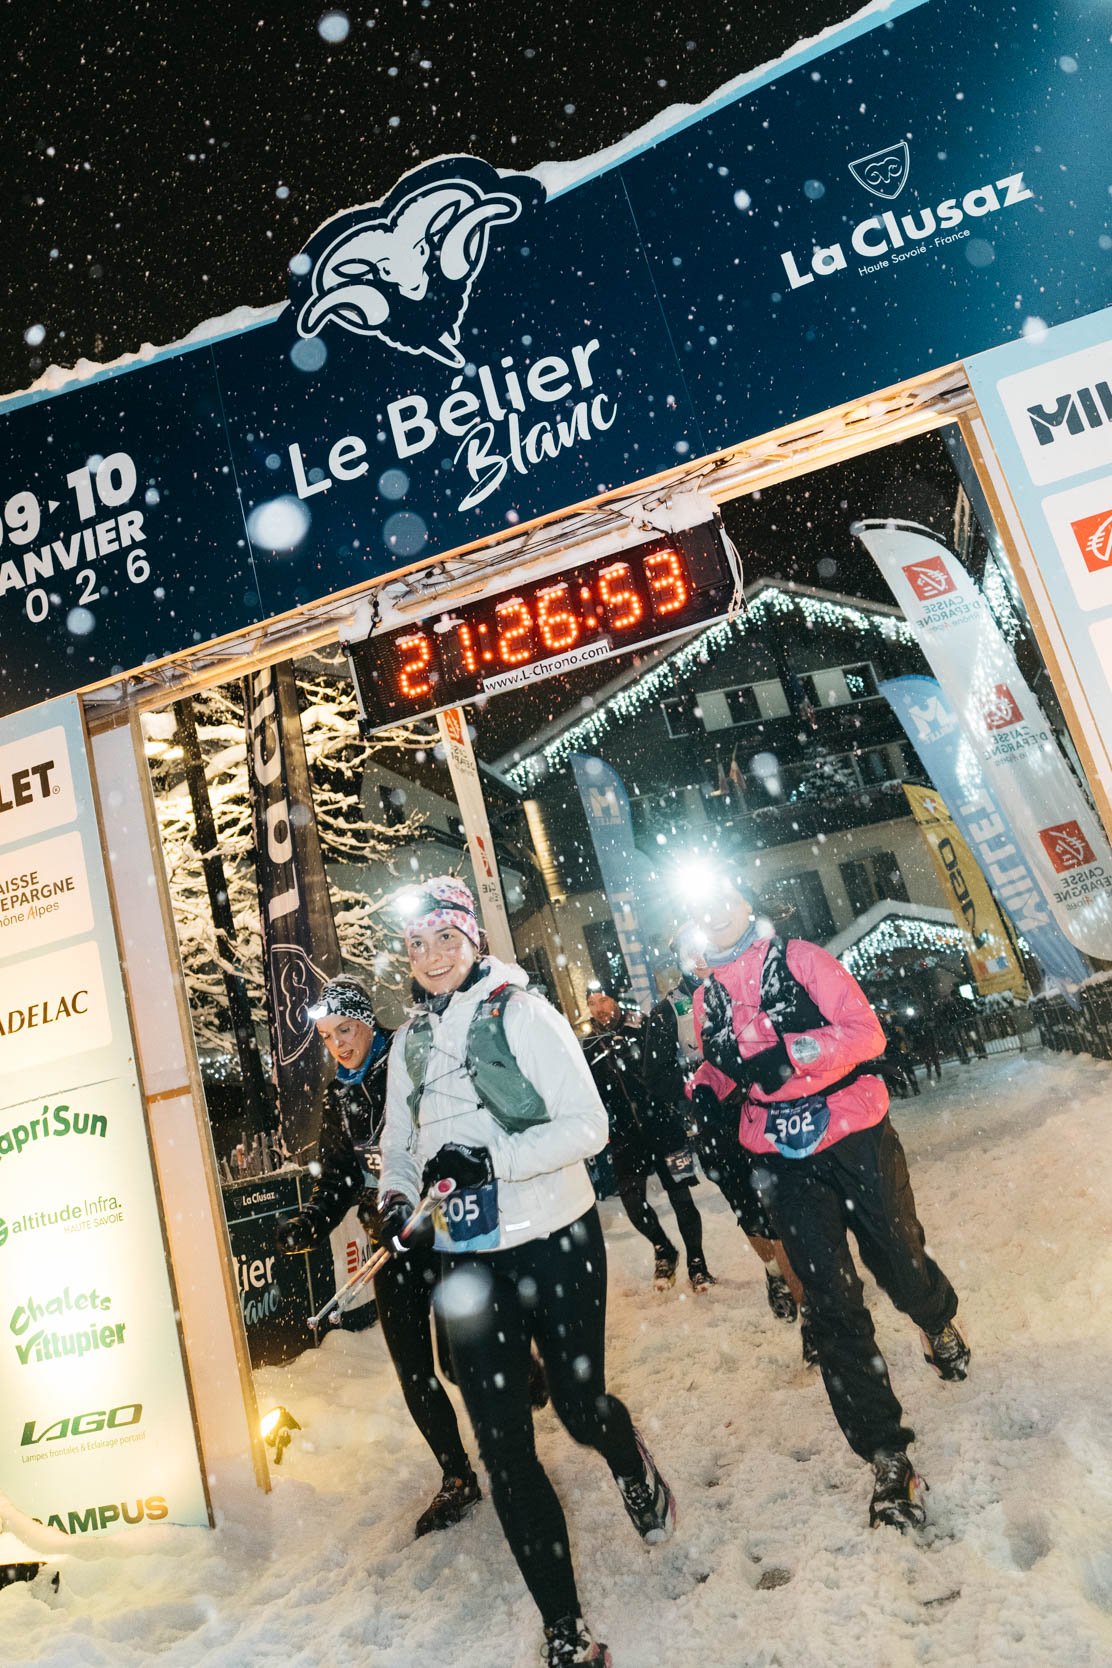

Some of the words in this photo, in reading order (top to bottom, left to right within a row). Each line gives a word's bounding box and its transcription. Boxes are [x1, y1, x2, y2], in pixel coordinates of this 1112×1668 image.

[781, 243, 848, 289] La
[851, 172, 1034, 257] Clusaz
[858, 259, 890, 277] Haute
[891, 244, 927, 264] Savoie
[934, 229, 971, 248] France
[288, 435, 370, 500] Le
[387, 338, 600, 459] Bélier
[453, 393, 617, 512] Blanc
[0, 491, 41, 547] 9
[66, 452, 137, 521] 10
[398, 550, 689, 698] 21:26:53
[484, 643, 609, 692] www.L-Chrono.com
[27, 901, 60, 920] Alpes
[93, 1211, 124, 1228] SAVOIE
[242, 1195, 252, 1206] La
[252, 1191, 276, 1203] Clusaz
[9, 1286, 112, 1336] Chalets
[15, 1322, 126, 1365] Vittupier
[20, 1403, 143, 1446] LAGO
[22, 1451, 49, 1463] Lampes
[32, 1496, 169, 1535] AMPUS
